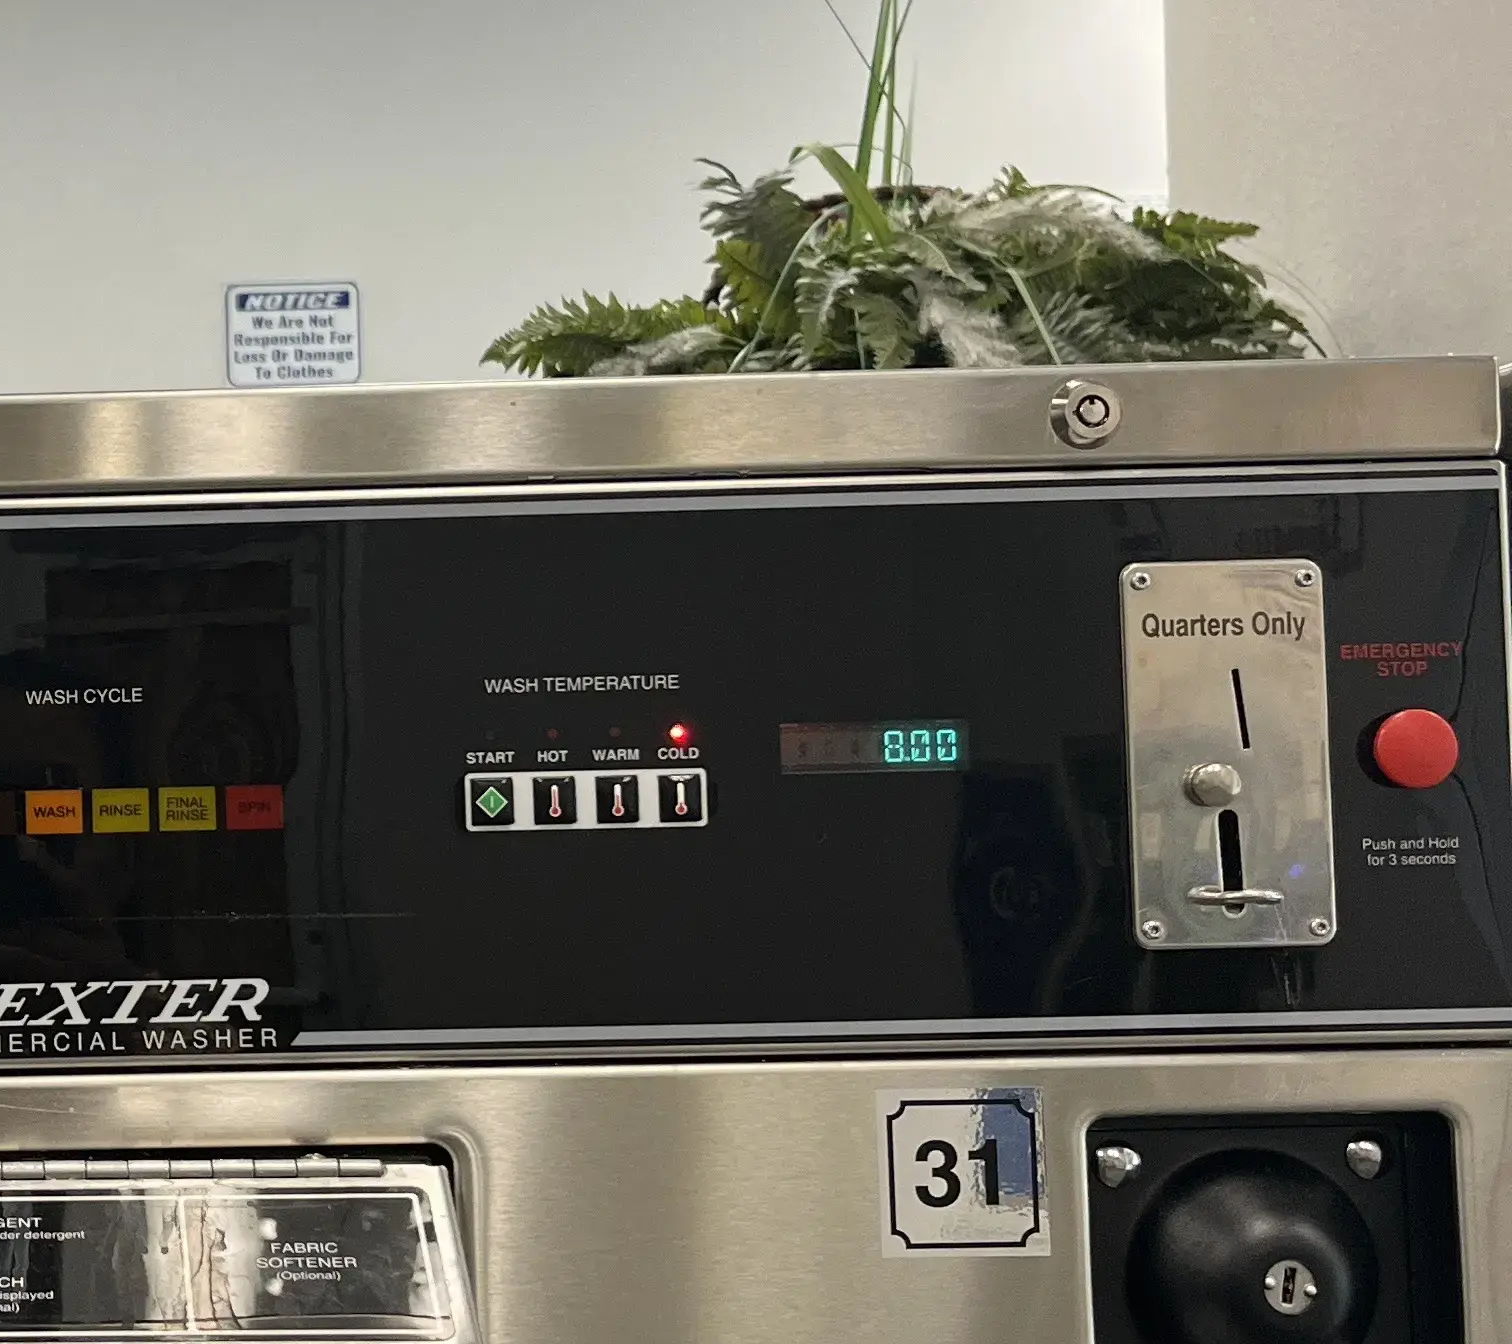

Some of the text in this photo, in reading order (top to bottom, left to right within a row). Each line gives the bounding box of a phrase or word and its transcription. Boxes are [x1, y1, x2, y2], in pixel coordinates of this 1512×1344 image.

[244, 291, 340, 310] NOTICE
[252, 314, 334, 329] We Are Not
[234, 332, 353, 349] Responsible For
[234, 348, 353, 364] Loss Or Damage
[255, 365, 333, 380] To Clothes
[1141, 611, 1306, 640] Quarters Only
[1340, 642, 1463, 661] EMERGENCY
[1377, 661, 1428, 676] STOP
[484, 674, 680, 693] WASH TEMPERATURE
[25, 687, 143, 705] WASH CYCLE
[466, 751, 515, 764] START
[537, 750, 568, 762] HOT
[593, 749, 640, 761] WARM
[657, 747, 700, 760] COLD
[167, 797, 207, 808] FINAL
[33, 805, 76, 819] WASH
[99, 804, 142, 818] RINSE
[166, 809, 209, 821] RINSE
[1362, 836, 1459, 851] Push and Hold
[1367, 852, 1456, 866] for 3 seconds
[142, 1028, 278, 1050] WASHER
[915, 1139, 999, 1208] 31
[24, 1230, 86, 1241] detergent
[270, 1242, 338, 1254] FABRIC
[256, 1257, 357, 1268] SOFTENER
[276, 1271, 341, 1281] (Optional)
